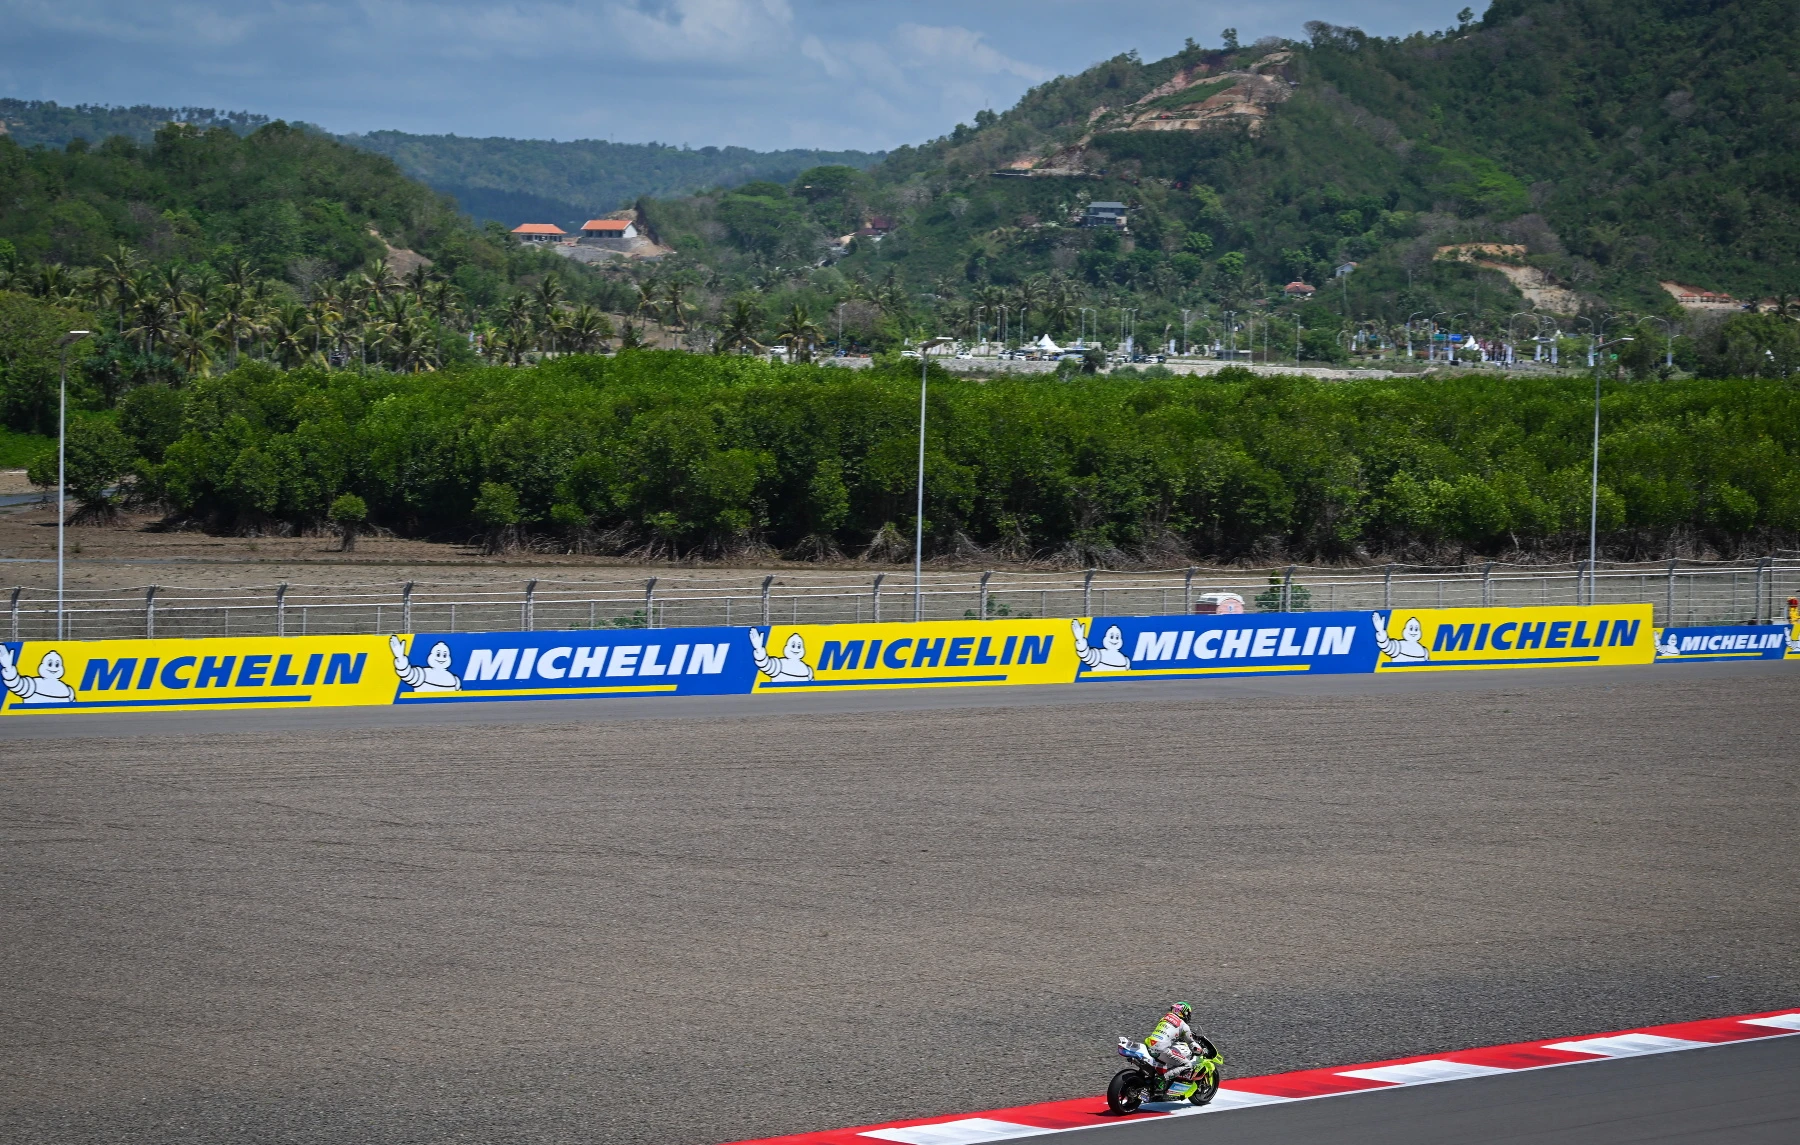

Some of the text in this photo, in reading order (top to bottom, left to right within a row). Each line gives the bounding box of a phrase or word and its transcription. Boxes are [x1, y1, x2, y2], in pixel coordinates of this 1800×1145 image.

[817, 635, 1054, 671] MICHELIN
[1132, 626, 1357, 662] MICHELIN
[1432, 619, 1641, 652] MICHELIN
[1680, 633, 1784, 652] MICHELIN
[79, 653, 367, 691] MICHELIN
[463, 643, 730, 681] MICHELIN
